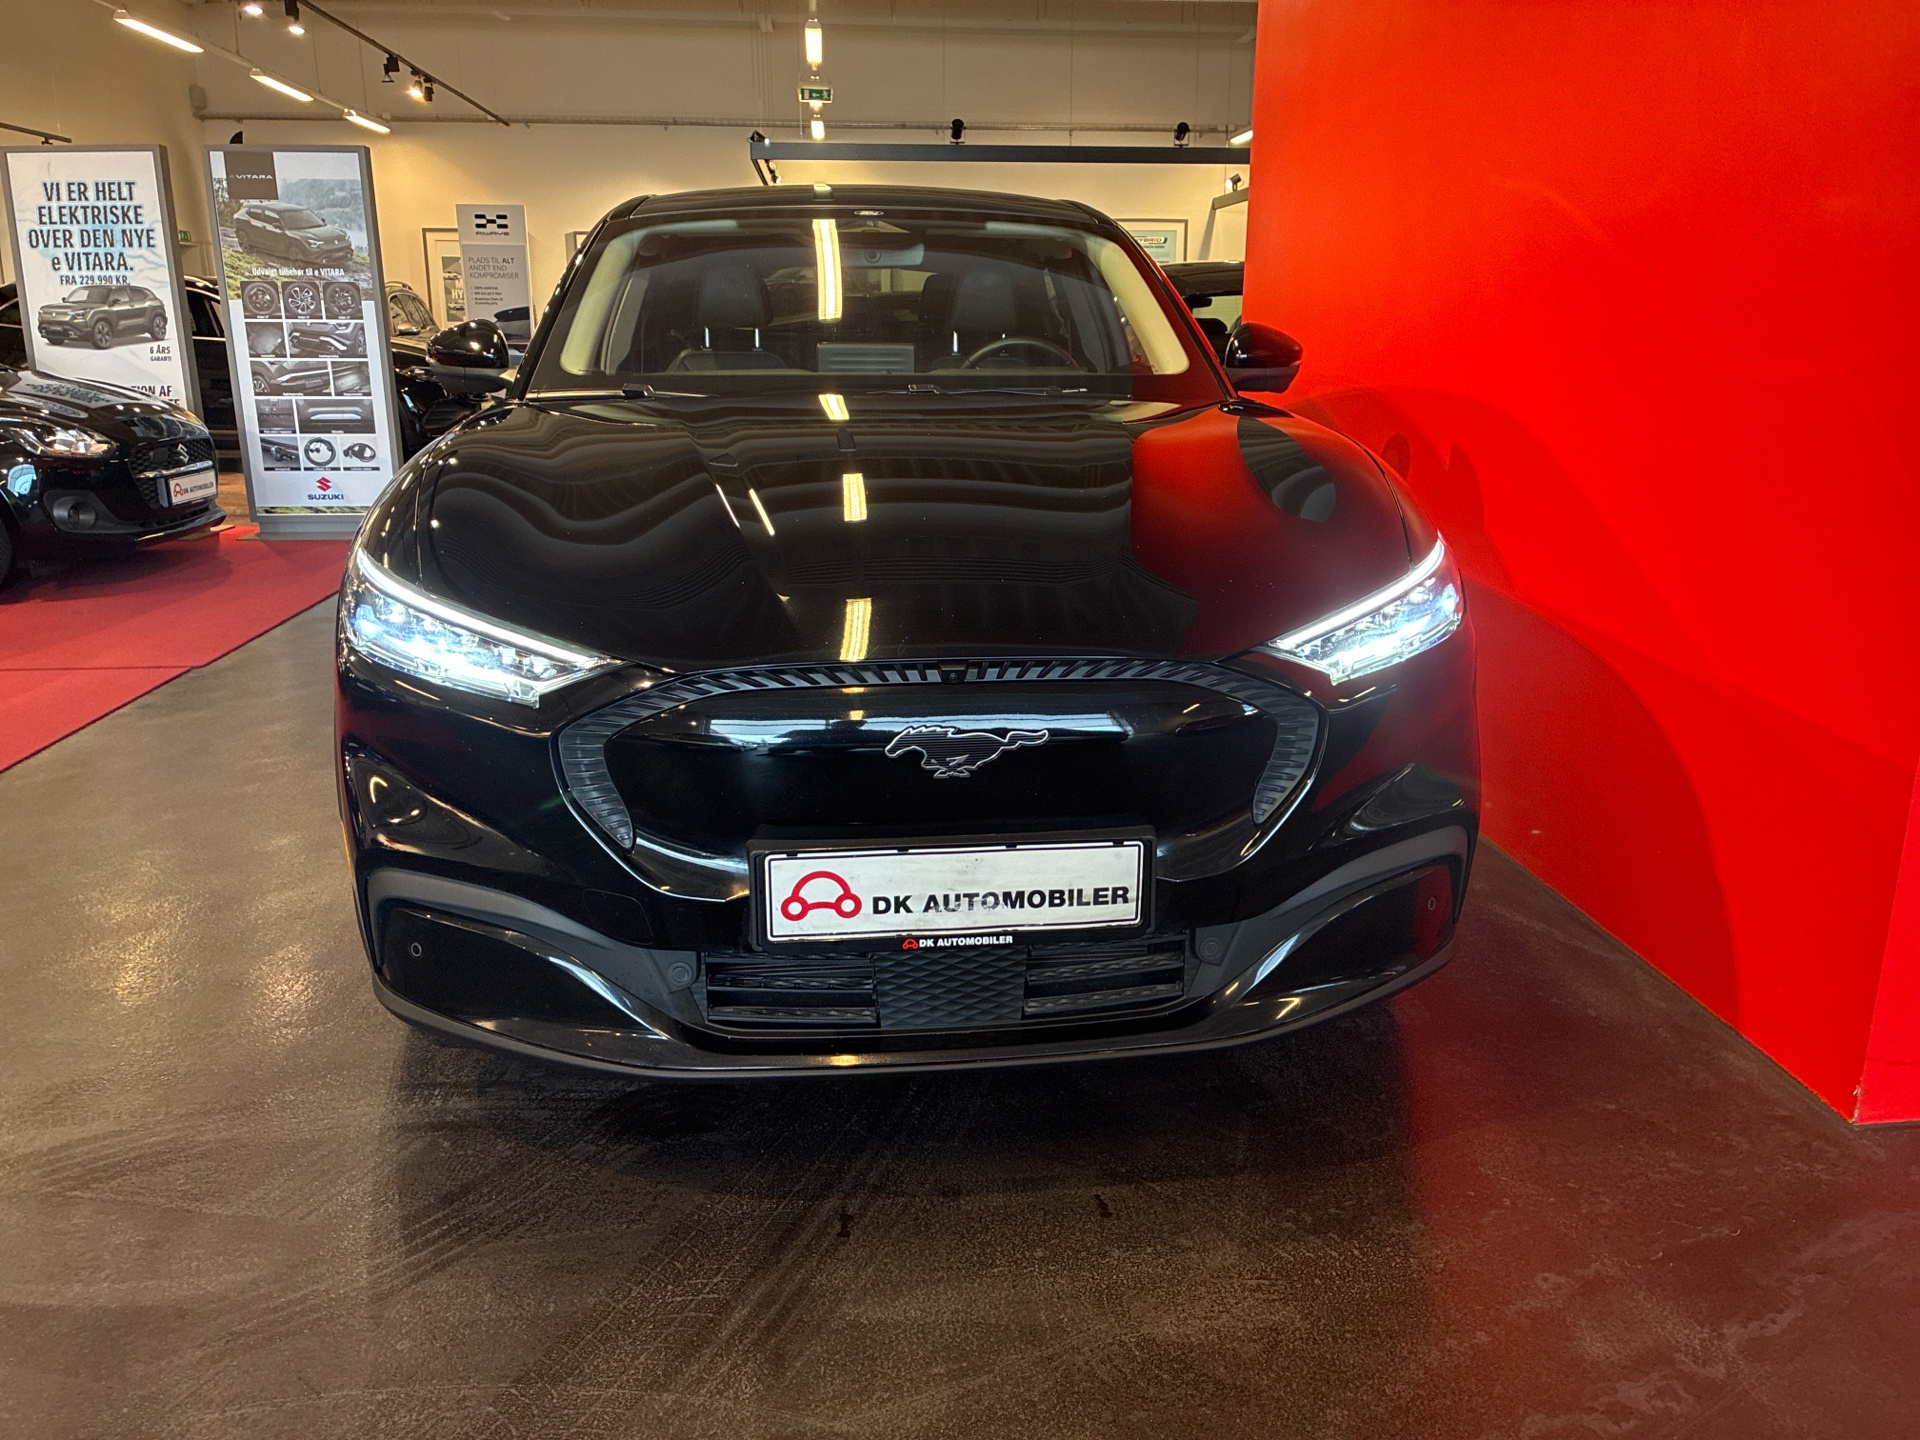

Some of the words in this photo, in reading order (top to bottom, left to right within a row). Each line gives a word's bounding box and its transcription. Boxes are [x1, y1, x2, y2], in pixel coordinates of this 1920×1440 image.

[43, 182, 60, 201] VI
[67, 182, 89, 201] ER
[95, 182, 136, 201] HELT
[38, 206, 144, 224] ELEKTRISKE
[28, 229, 74, 248] OVER
[80, 229, 114, 248] DEN
[122, 229, 156, 248] NYE
[52, 256, 60, 271] e
[64, 252, 134, 270] VITARA.
[60, 276, 77, 285] FRA
[80, 276, 113, 285] 229.990
[156, 345, 170, 354] ÅRS
[159, 386, 172, 396] AF
[872, 895, 914, 914] DK
[922, 886, 1130, 913] AUTOMOBILER
[919, 938, 934, 948] DK
[937, 936, 1013, 946] AUTOMOBILER
